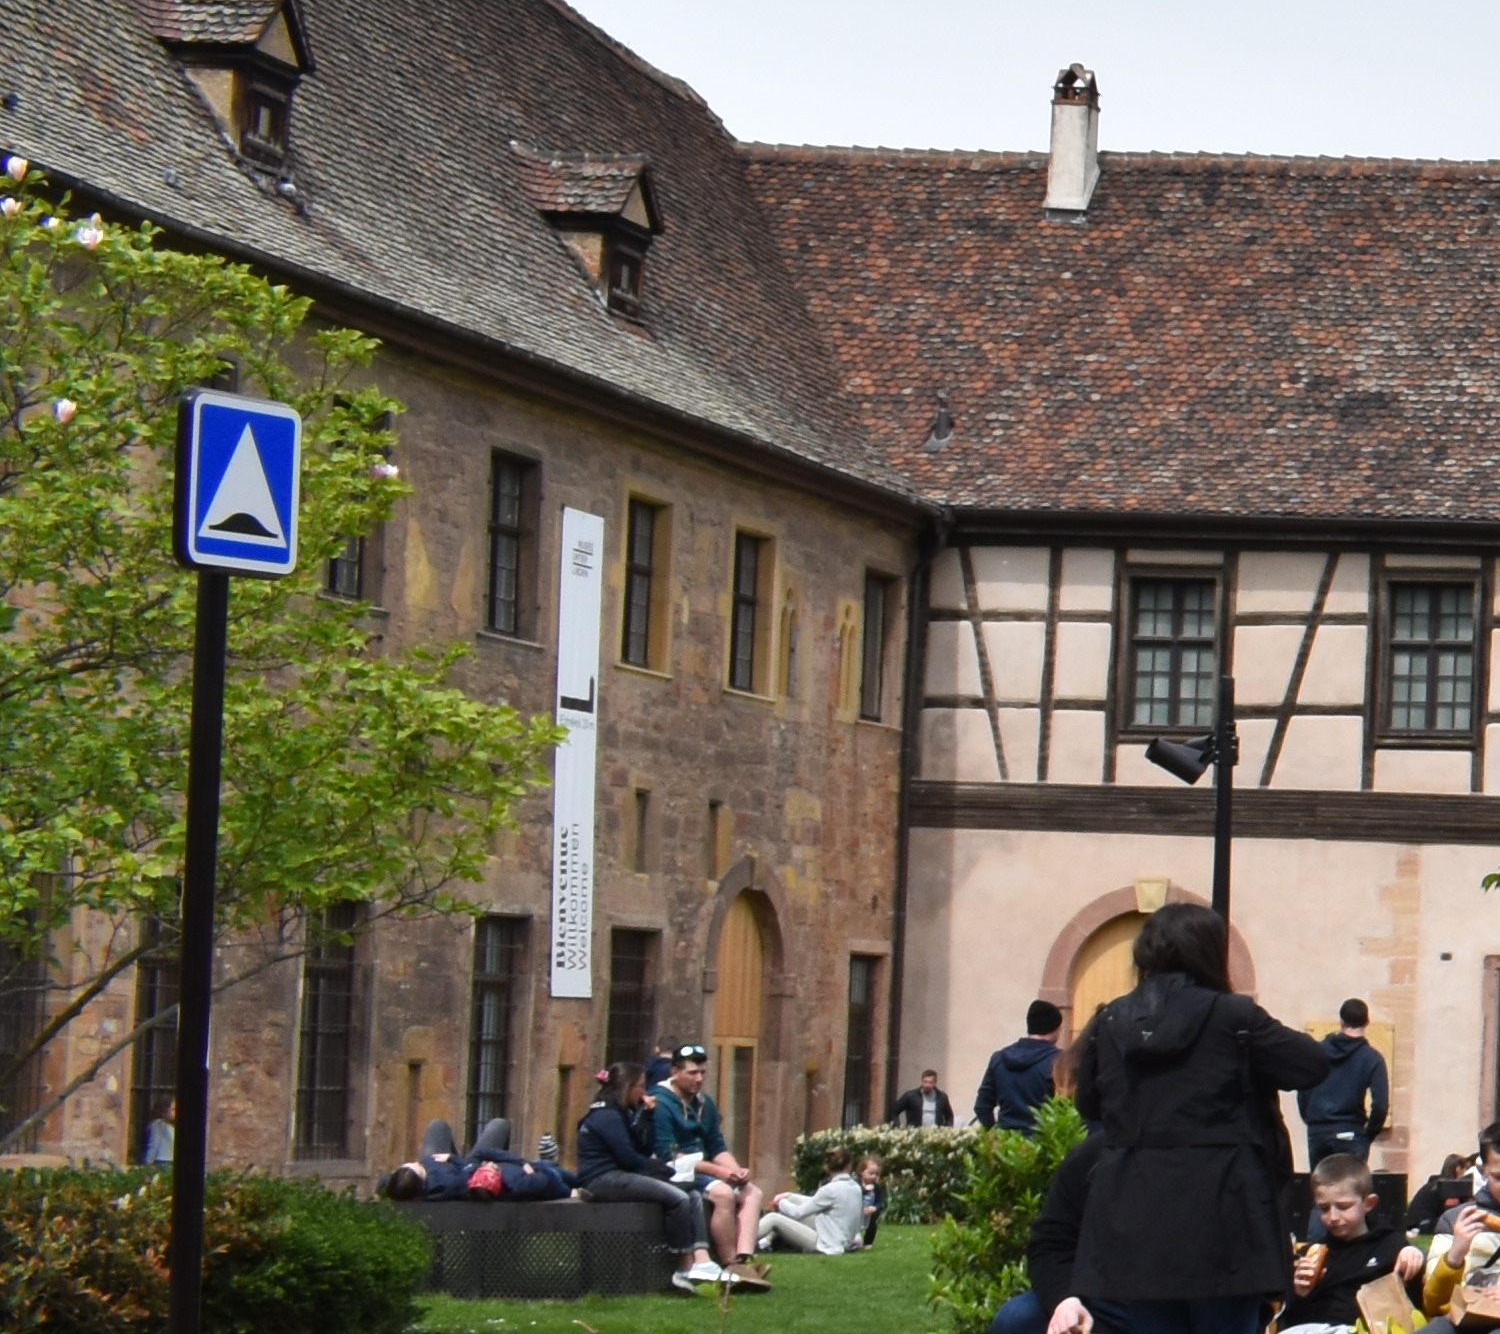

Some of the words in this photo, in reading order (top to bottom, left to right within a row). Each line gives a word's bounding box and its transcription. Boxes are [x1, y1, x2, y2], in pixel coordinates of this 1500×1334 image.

[556, 826, 568, 968] Bienvenue
[567, 823, 579, 970] Willkommen
[578, 863, 588, 970] Welcome
